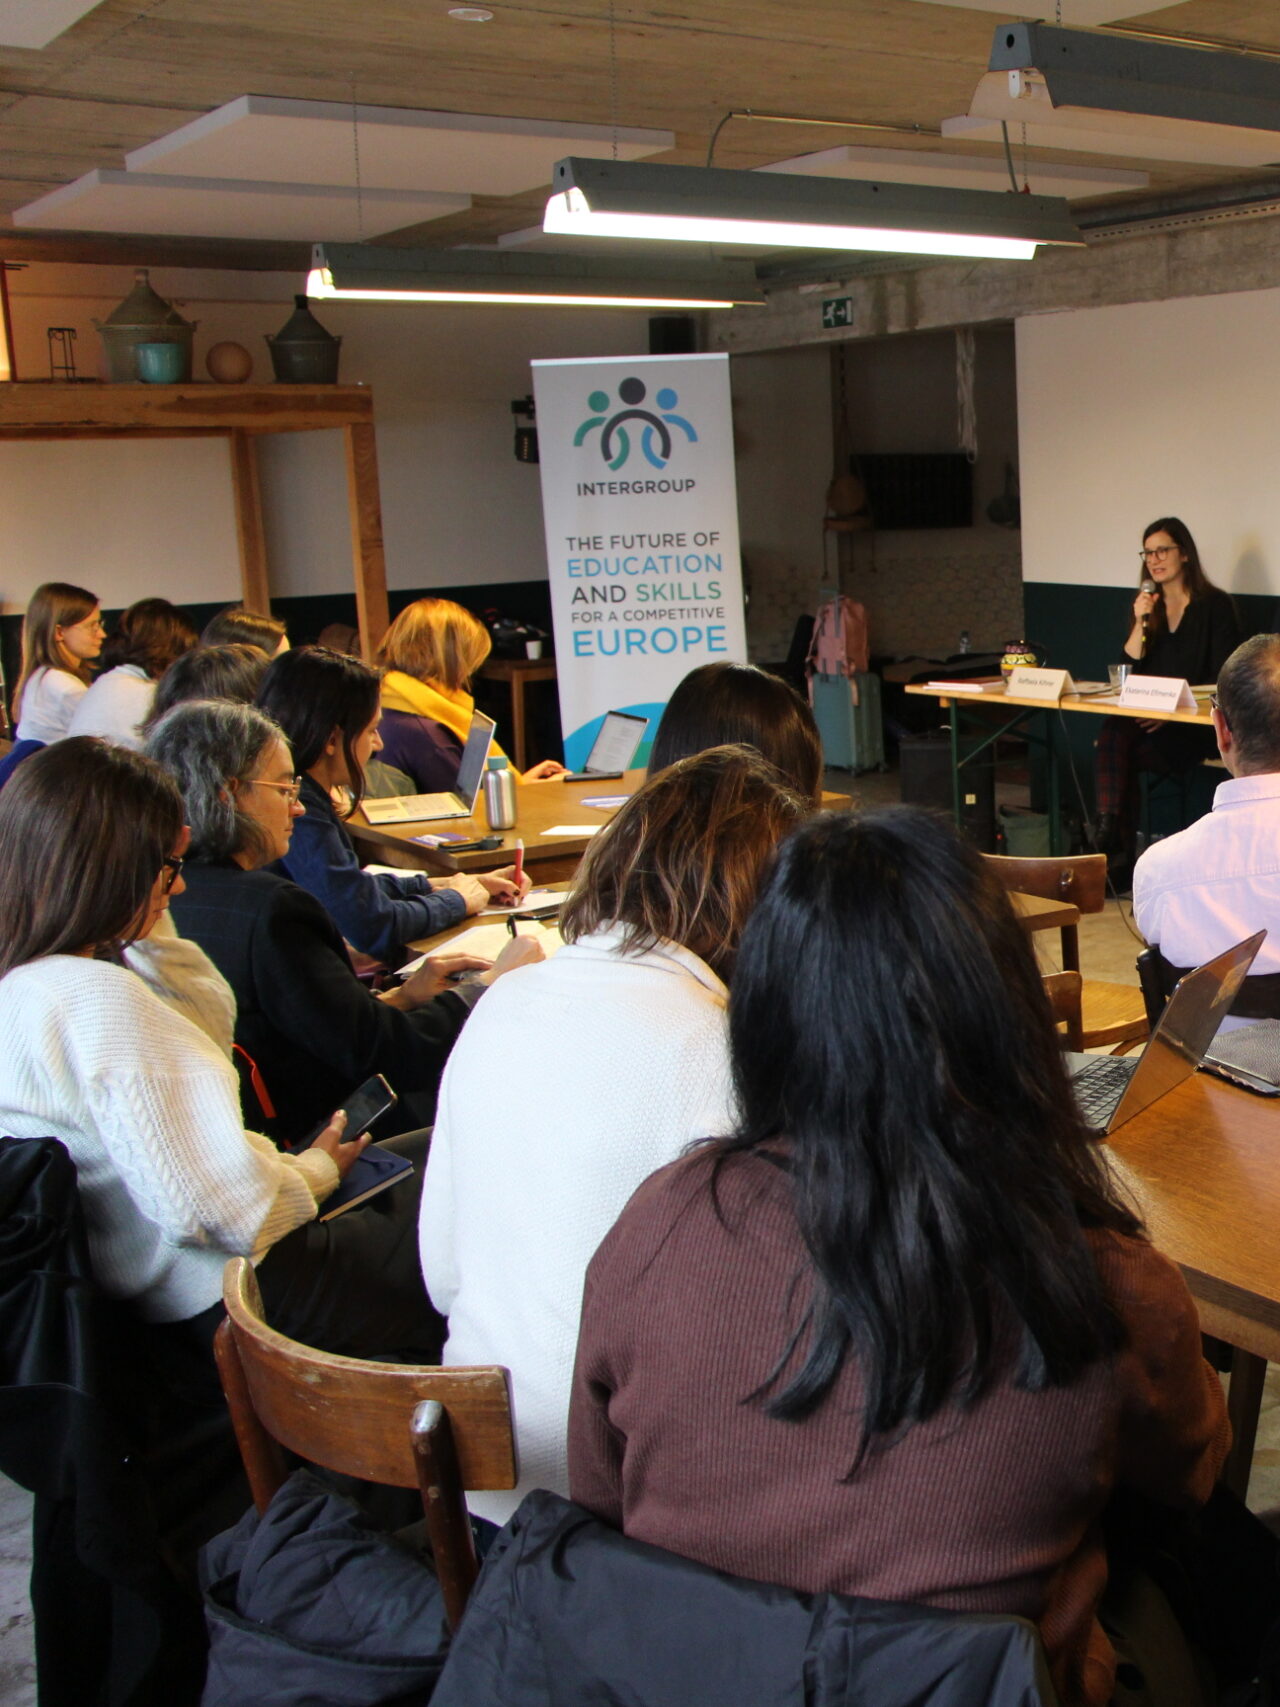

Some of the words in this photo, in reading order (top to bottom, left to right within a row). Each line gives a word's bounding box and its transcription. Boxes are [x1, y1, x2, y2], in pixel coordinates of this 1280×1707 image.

[576, 479, 696, 496] INTERGROUP
[566, 536, 603, 551] THE
[610, 533, 686, 549] FUTURE
[693, 531, 720, 547] OF
[567, 553, 723, 578] EDUCATION
[571, 585, 626, 605] AND
[635, 581, 722, 602] SKILLS
[571, 611, 603, 624] FOR
[608, 611, 618, 622] A
[623, 607, 725, 621] COMPETITIVE
[572, 625, 728, 657] EUROPE
